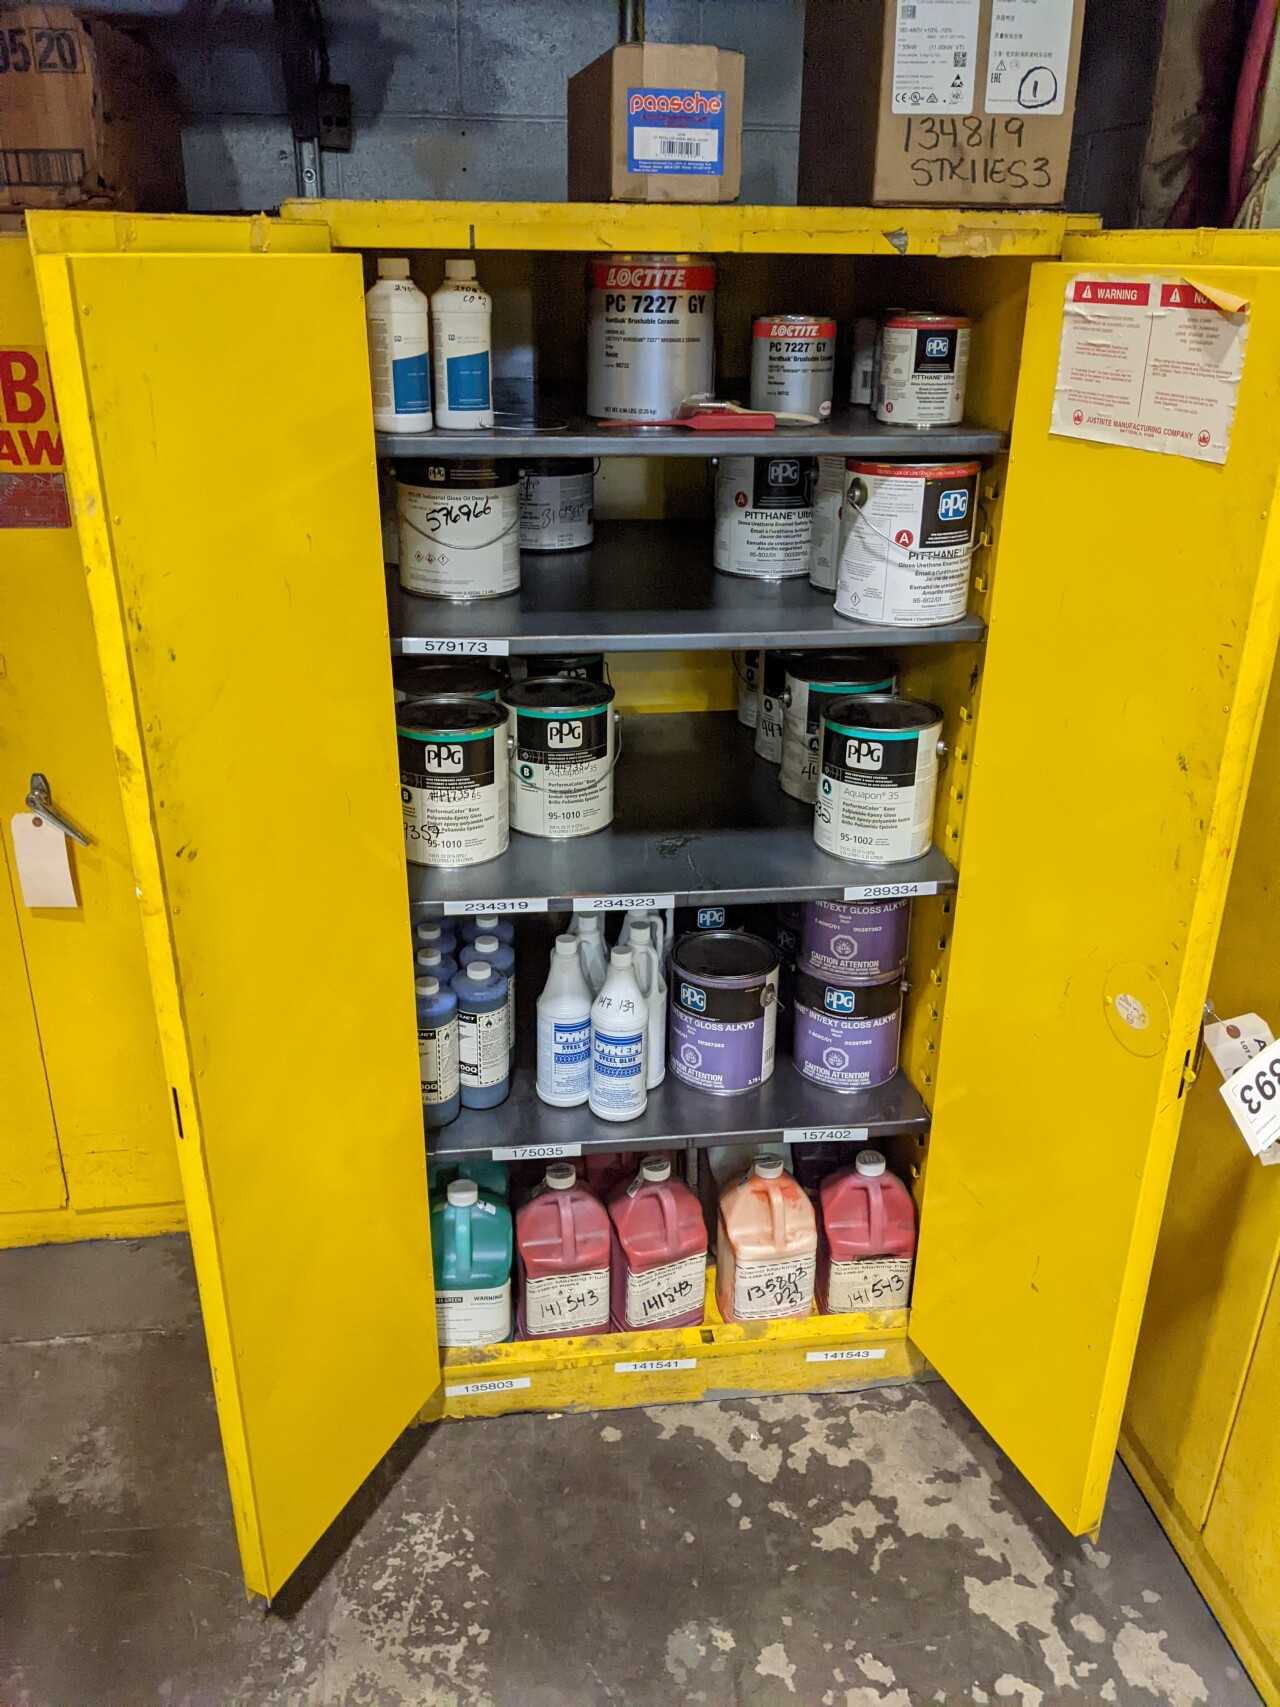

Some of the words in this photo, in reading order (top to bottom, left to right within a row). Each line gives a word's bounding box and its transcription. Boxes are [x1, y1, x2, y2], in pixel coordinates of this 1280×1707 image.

[36, 31, 77, 71] 20
[904, 116, 1025, 152] 134819
[606, 268, 686, 287] LOCTITE
[1097, 288, 1138, 301] WARNING
[605, 294, 626, 313] PC
[632, 296, 678, 313] 7227
[688, 295, 706, 313] GY
[771, 325, 820, 337] LOCTITE
[769, 342, 781, 352] PC
[785, 342, 809, 353] 7227
[926, 339, 948, 357] PPG
[0, 351, 59, 423] B
[1113, 419, 1163, 434] MANUFACTURING
[1163, 427, 1194, 440] COMPANY
[770, 464, 798, 482] PPG
[941, 492, 966, 517] PPG
[426, 499, 492, 532] 576966
[745, 511, 793, 520] PITTHANE
[899, 532, 909, 544] A
[909, 548, 960, 561] PITTHANE
[424, 641, 488, 653] 579173
[550, 721, 581, 743] PPG
[427, 745, 461, 768] PPG
[848, 740, 881, 764] PPG
[844, 788, 882, 800] Aquapon
[888, 791, 899, 800] 35
[548, 811, 581, 820] 95-1010
[427, 840, 462, 848] 95-1010
[840, 832, 873, 845] 95-1002
[863, 884, 919, 897] 289334
[464, 901, 529, 912] 234319
[593, 898, 656, 908] 234323
[849, 905, 881, 914] GLOSS
[700, 909, 724, 927] PPG
[811, 951, 839, 966] CAUTION
[839, 959, 880, 969] ATTENTION
[682, 986, 704, 1006] PPG
[827, 990, 853, 1009] PPG
[694, 1019, 724, 1031] GLOSS
[725, 1021, 755, 1032] ALKYD
[809, 1010, 838, 1028] INT/EXT
[841, 1020, 871, 1030] GLOSS
[873, 1013, 897, 1028] ALKYD
[688, 1067, 723, 1082] ATTENTION
[804, 1061, 831, 1077] CAUTION
[831, 1070, 870, 1079] ATTENTION
[802, 1130, 851, 1140] 157402
[512, 1147, 564, 1158] 175035
[473, 1293, 503, 1302] WARNING
[824, 1351, 870, 1360] 141543
[632, 1360, 679, 1370] 141541
[464, 1380, 514, 1392] 135803
